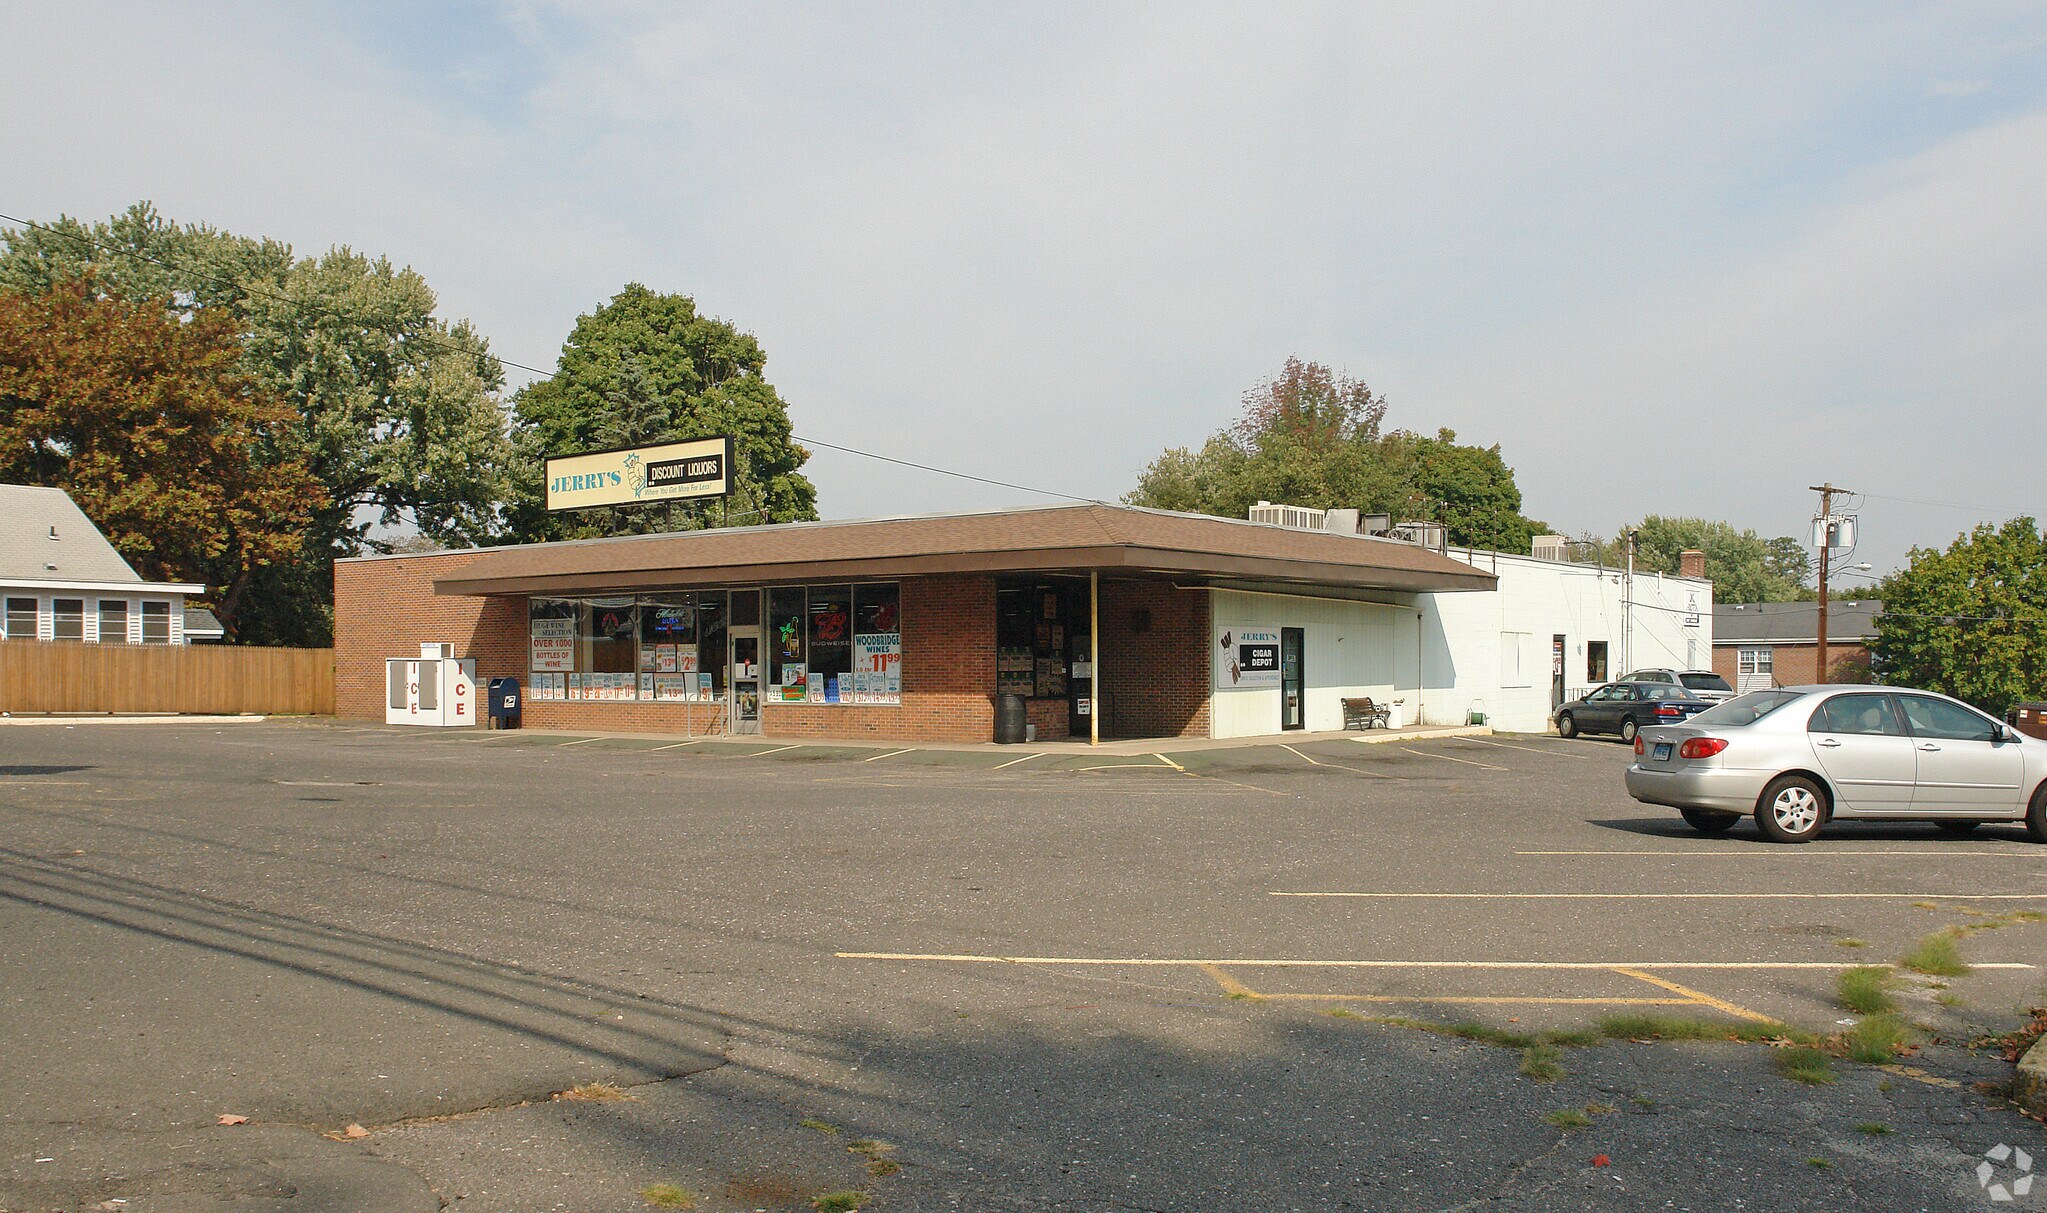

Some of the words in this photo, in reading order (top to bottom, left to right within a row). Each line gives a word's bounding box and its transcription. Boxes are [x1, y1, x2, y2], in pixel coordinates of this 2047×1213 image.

[651, 464, 684, 480] DISCOUNT
[688, 460, 717, 477] LIQUORS
[551, 470, 622, 493] JERRY'S
[556, 639, 572, 647] 1000
[855, 635, 900, 646] WOODBRIDGE
[1252, 649, 1272, 658] CIGAR
[455, 662, 466, 715] ICE
